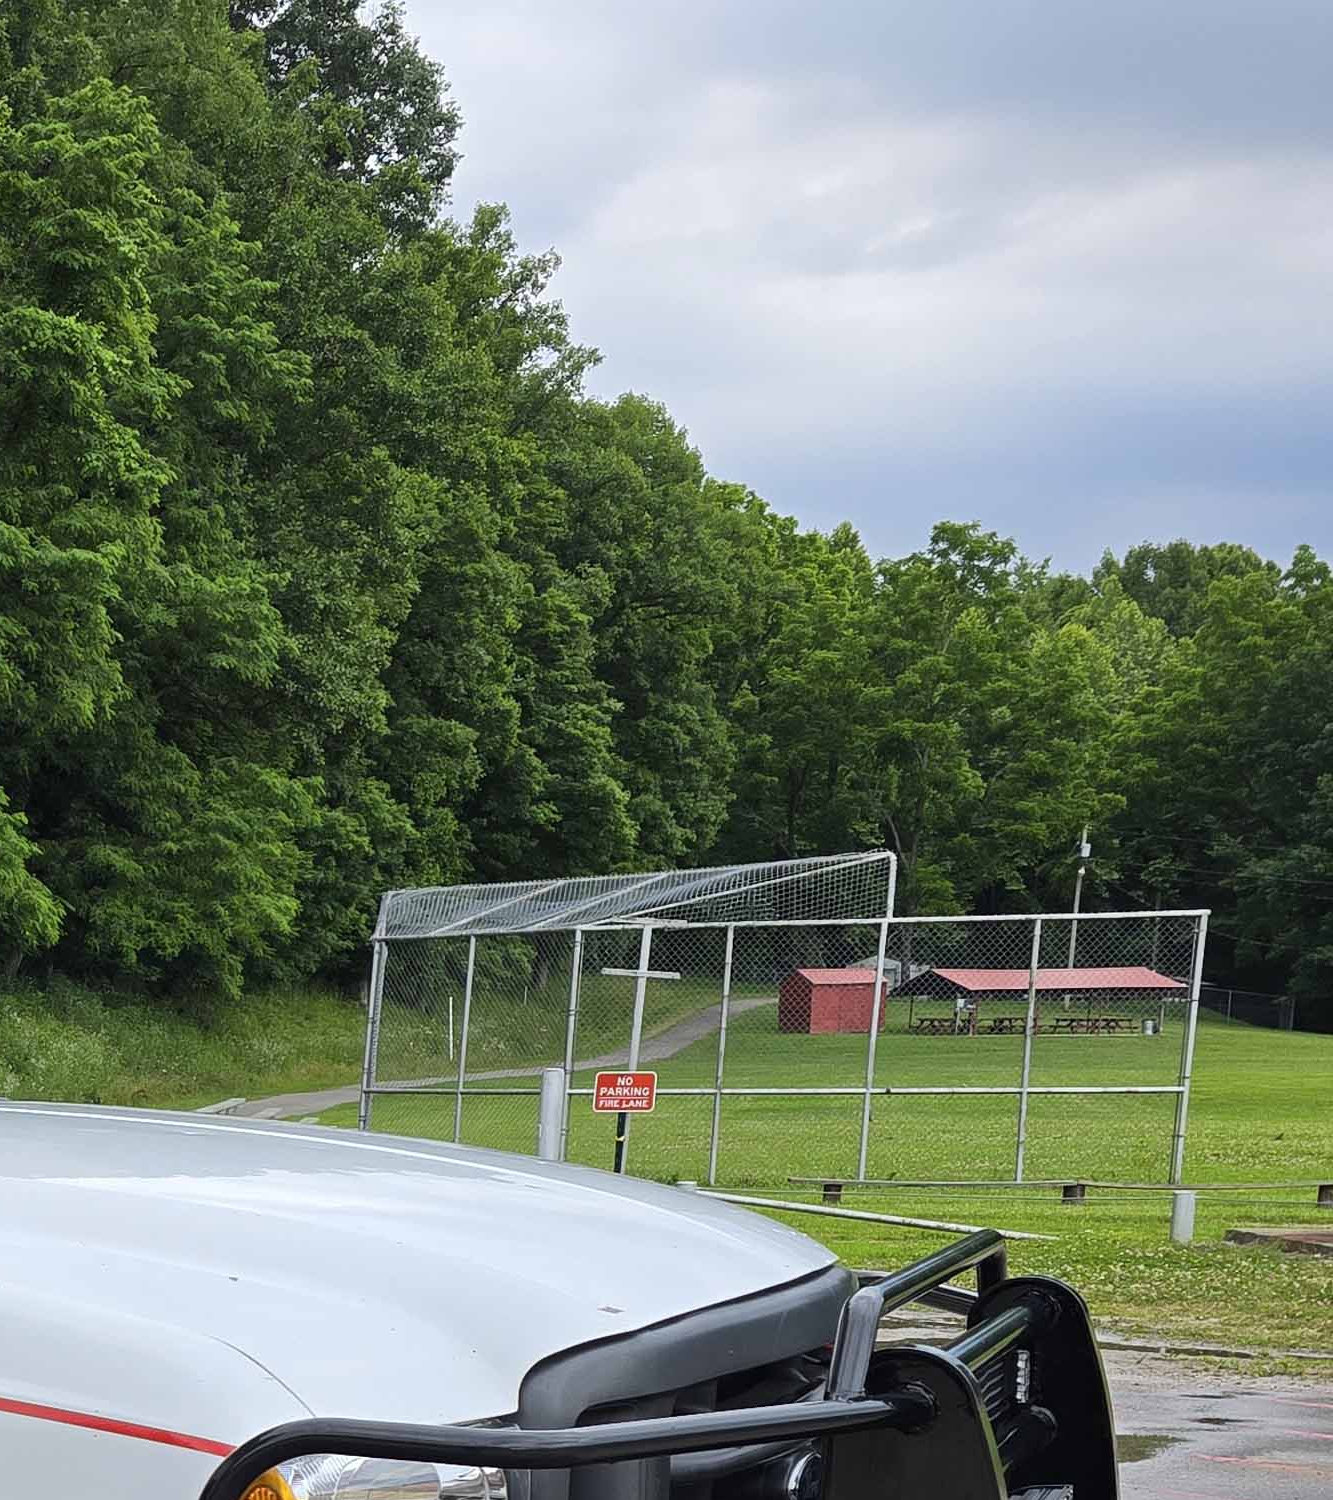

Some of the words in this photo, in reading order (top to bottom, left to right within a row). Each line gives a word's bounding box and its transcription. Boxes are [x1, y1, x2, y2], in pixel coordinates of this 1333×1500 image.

[617, 1075, 633, 1086] NO
[599, 1087, 650, 1097] PARKING
[598, 1098, 620, 1108] FIRE
[621, 1098, 649, 1109] LANE
